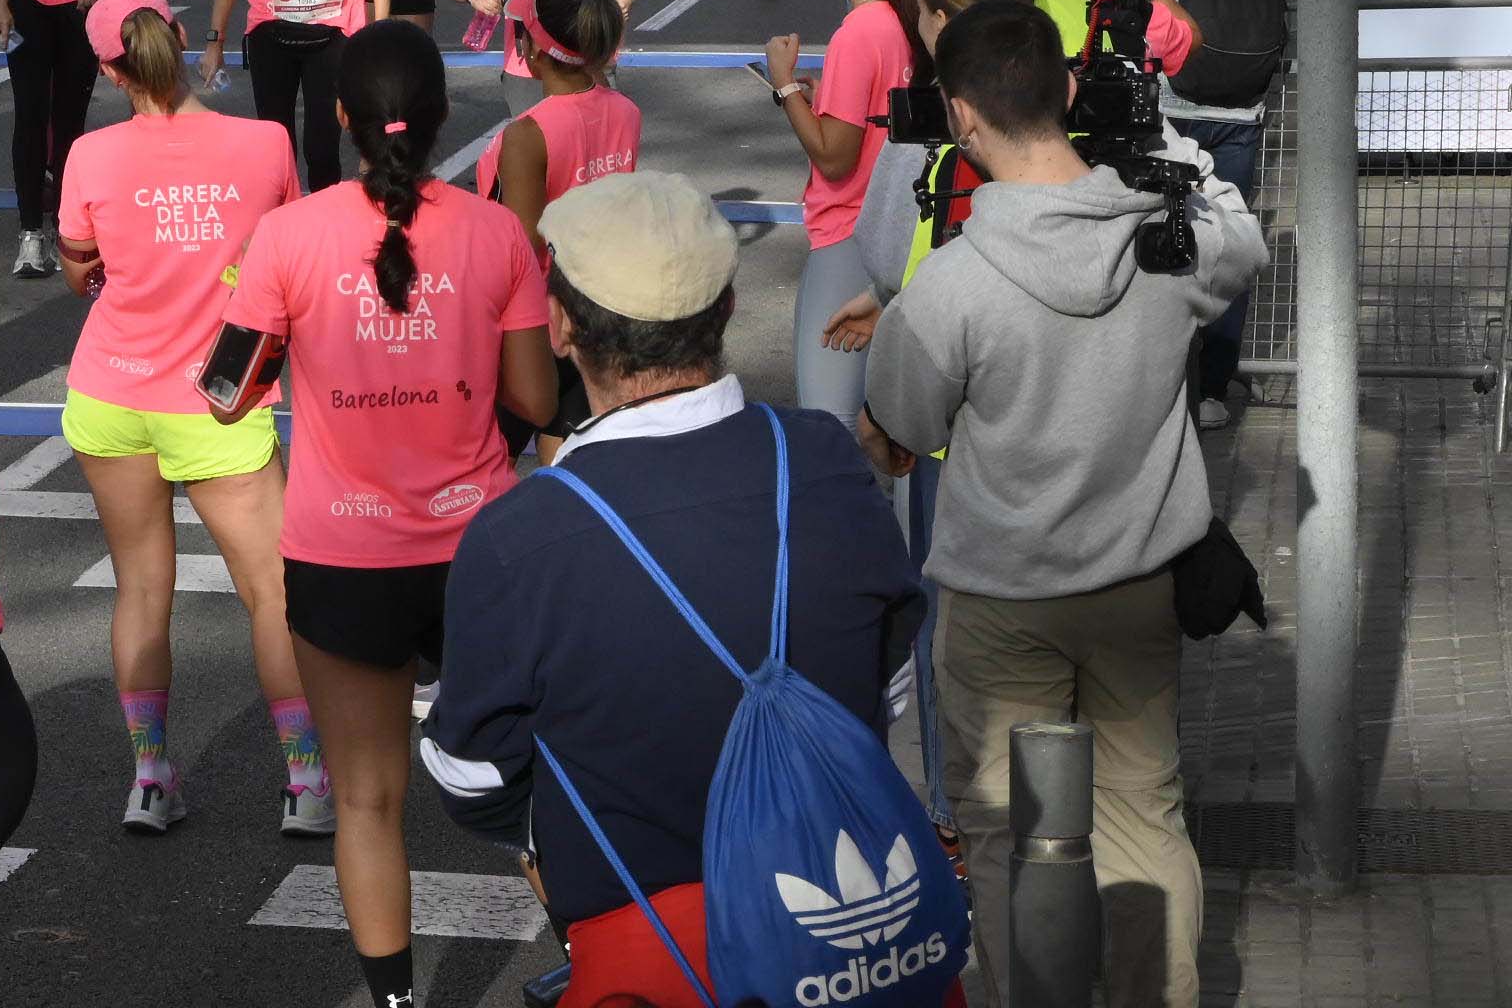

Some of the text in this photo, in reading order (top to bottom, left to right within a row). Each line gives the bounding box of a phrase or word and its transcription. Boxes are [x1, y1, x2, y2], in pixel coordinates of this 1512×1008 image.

[135, 184, 240, 207] CARRERA
[156, 204, 220, 224] DE LA
[155, 222, 225, 243] MUJER
[182, 244, 200, 252] 2023
[355, 319, 439, 342] MUJER
[387, 345, 408, 354] 2023
[330, 385, 440, 410] Barcelona
[331, 502, 393, 518] OYSHO
[433, 491, 482, 514] ASTURIANA
[795, 931, 948, 1008] adidas
